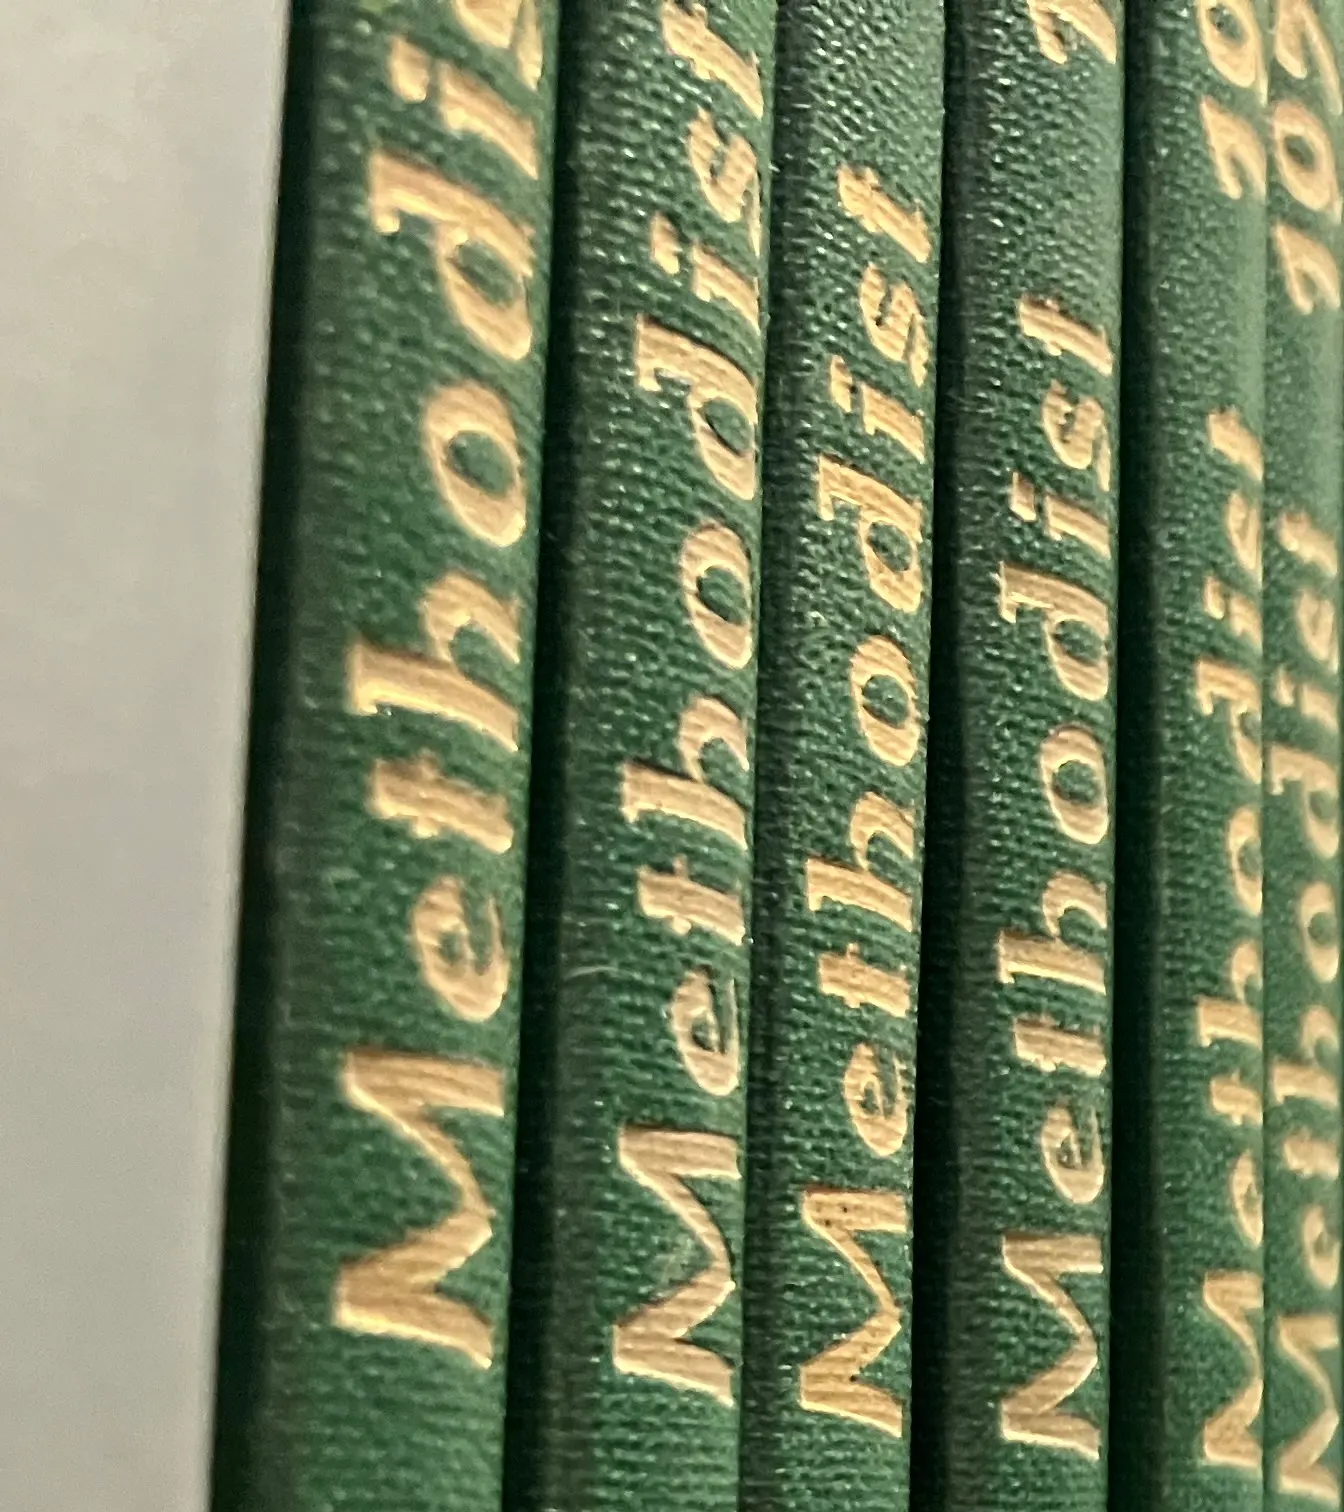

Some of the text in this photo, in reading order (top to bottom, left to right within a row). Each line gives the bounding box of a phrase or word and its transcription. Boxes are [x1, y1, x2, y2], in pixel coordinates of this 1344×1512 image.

[613, 0, 763, 1400] Methodist
[799, 163, 932, 1432] Methodist
[994, 293, 1113, 1454] Methodist
[1196, 408, 1264, 1469] Methodist
[1268, 511, 1340, 1501] Methodist
